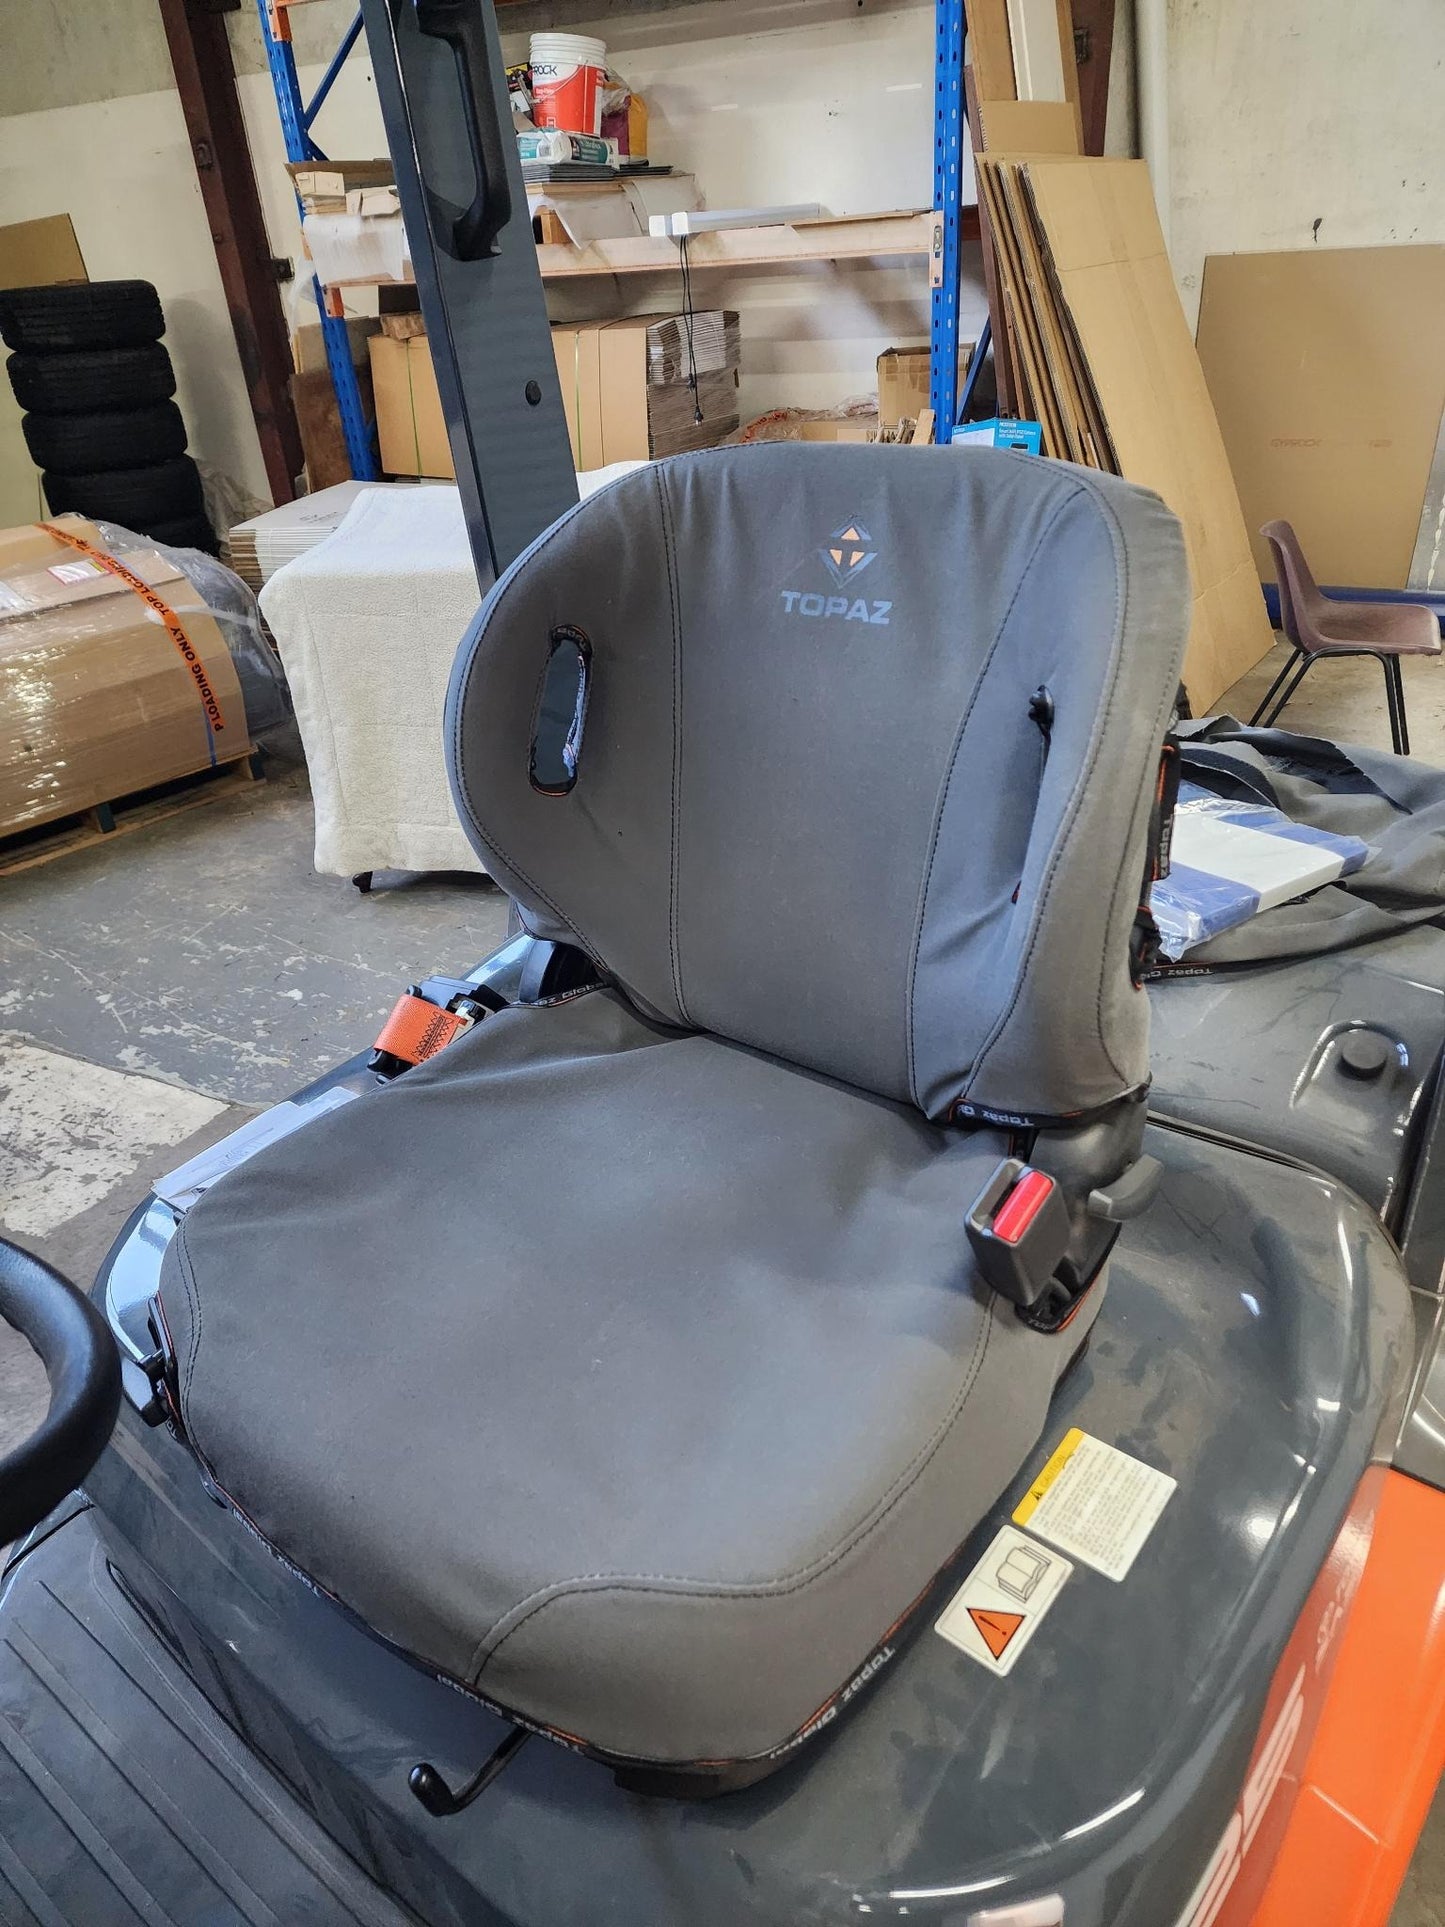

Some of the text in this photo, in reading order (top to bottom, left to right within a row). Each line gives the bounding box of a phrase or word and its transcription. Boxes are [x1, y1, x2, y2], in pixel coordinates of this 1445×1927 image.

[146, 594, 170, 615] TOP
[781, 590, 893, 625] TOPAZ
[170, 626, 196, 661] ONLY
[191, 663, 221, 722] LOADING
[1167, 967, 1214, 976] Topaz
[982, 1110, 1034, 1127] Topaz
[840, 1646, 896, 1702] Topaz
